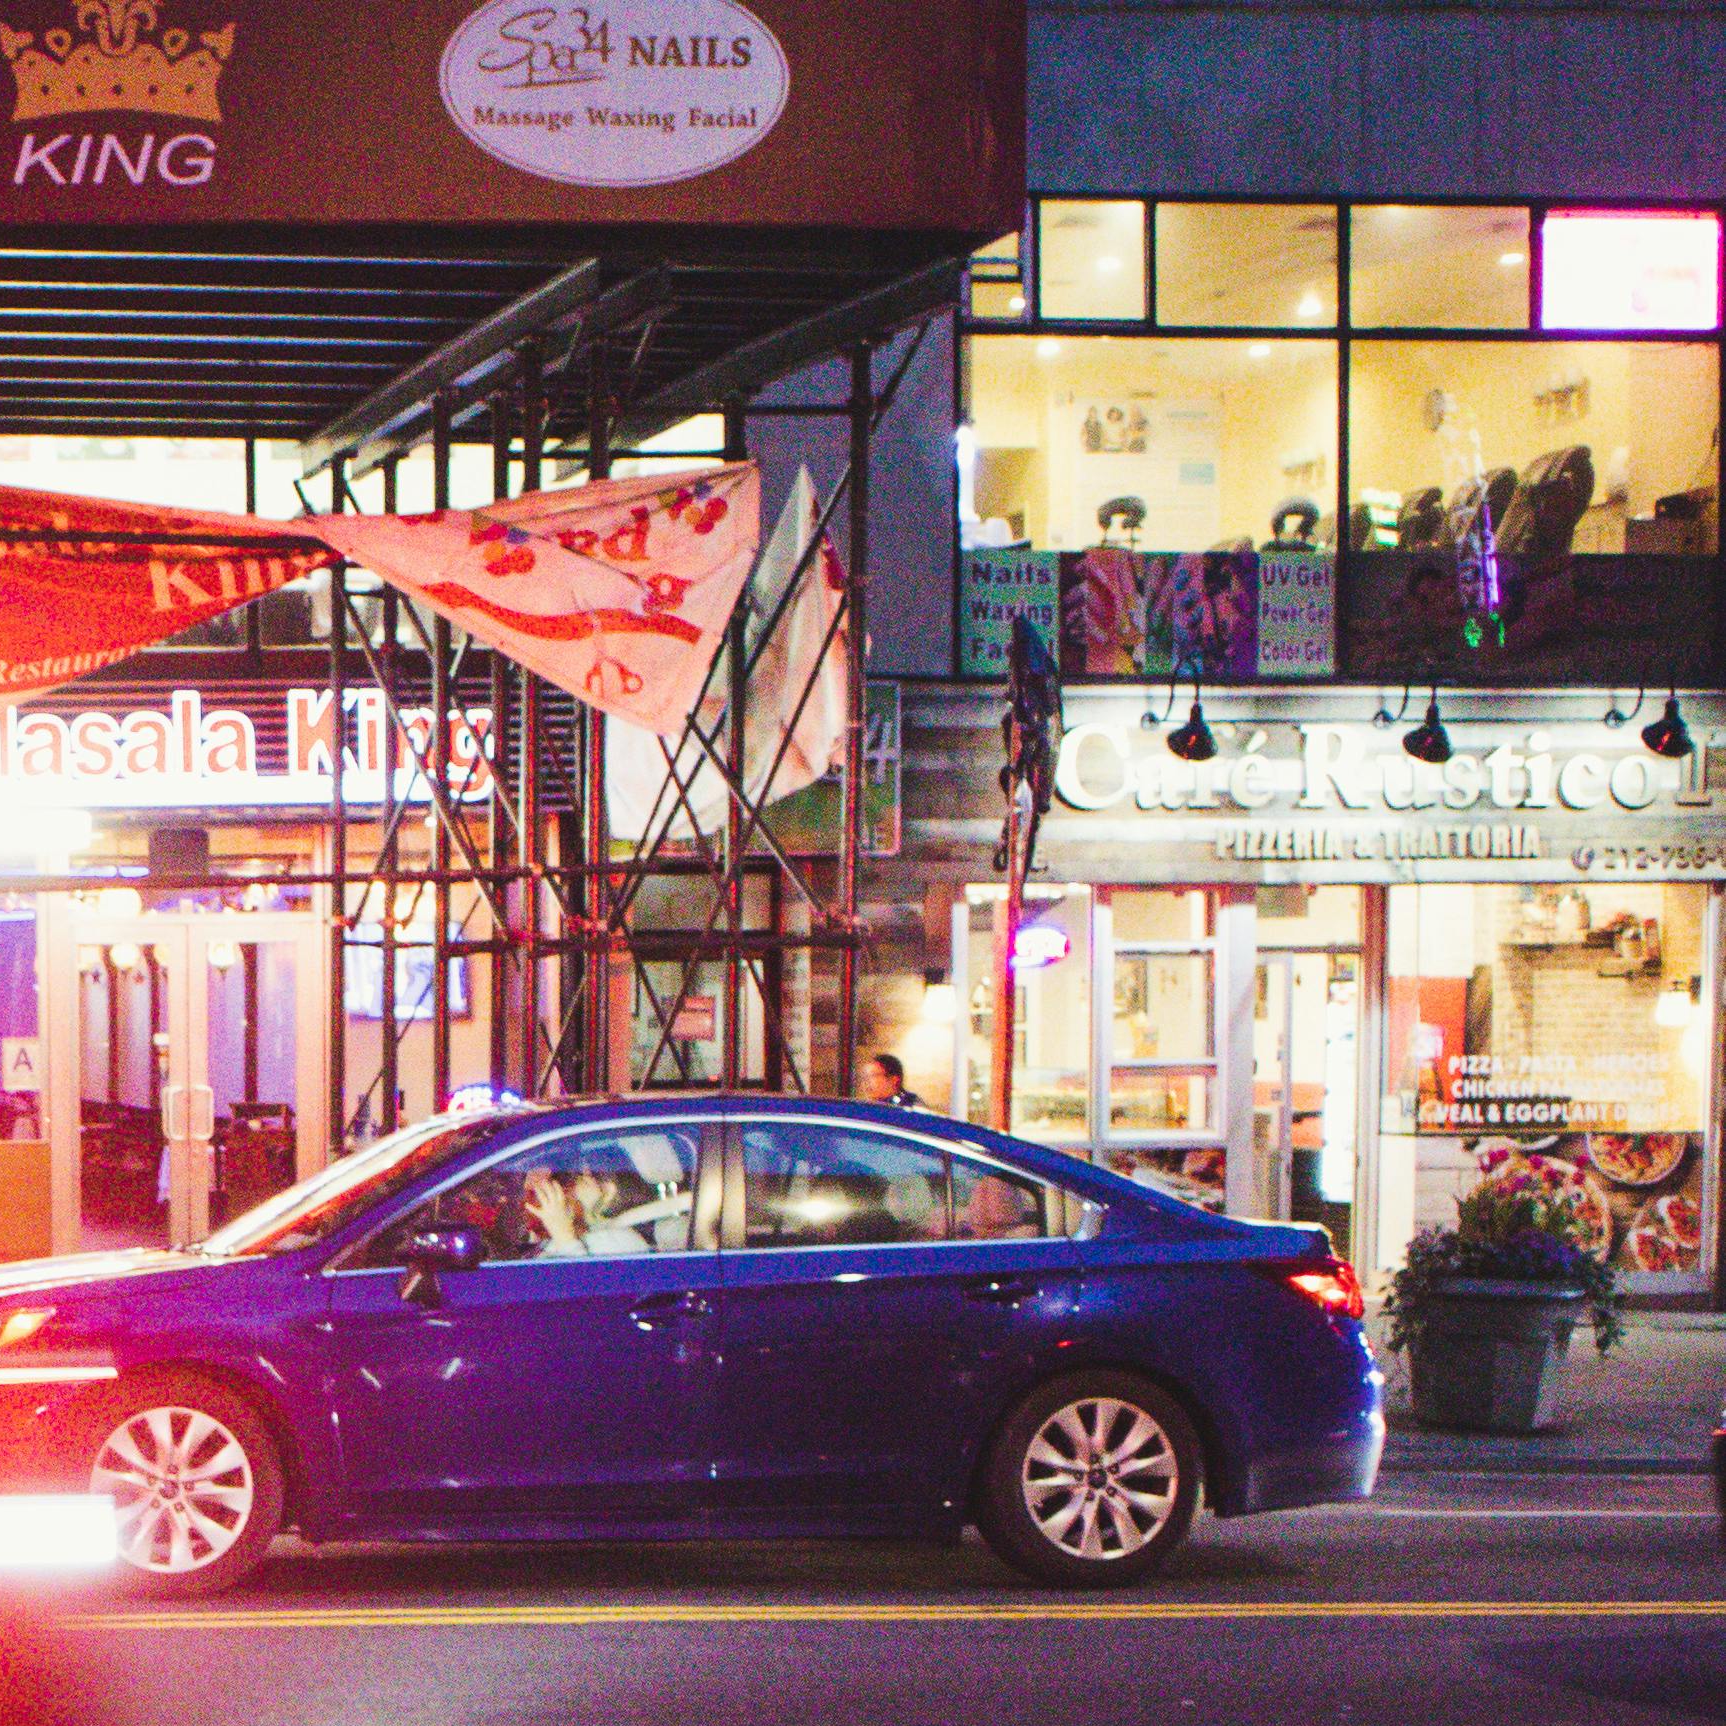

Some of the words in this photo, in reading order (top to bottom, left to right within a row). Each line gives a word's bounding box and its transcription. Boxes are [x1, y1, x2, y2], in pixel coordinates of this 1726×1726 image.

[629, 36, 752, 68] NAILS
[473, 106, 574, 132] Massage
[585, 106, 676, 133] Waxing
[688, 107, 758, 129] Facial
[12, 131, 217, 187] KING
[970, 563, 1052, 585] Nails
[1262, 564, 1292, 586] UV
[1296, 564, 1331, 586] Gel
[1300, 721, 1660, 812] Rustico
[1214, 826, 1345, 861] PIZZERIA
[1382, 824, 1541, 860] TRATTORIA
[12, 1046, 34, 1073] A
[1447, 1055, 1504, 1075] PIZZA
[1450, 1080, 1535, 1100] CHICKEN
[1438, 1103, 1484, 1124] VEAL
[1504, 1102, 1609, 1124] EGGPLANT
